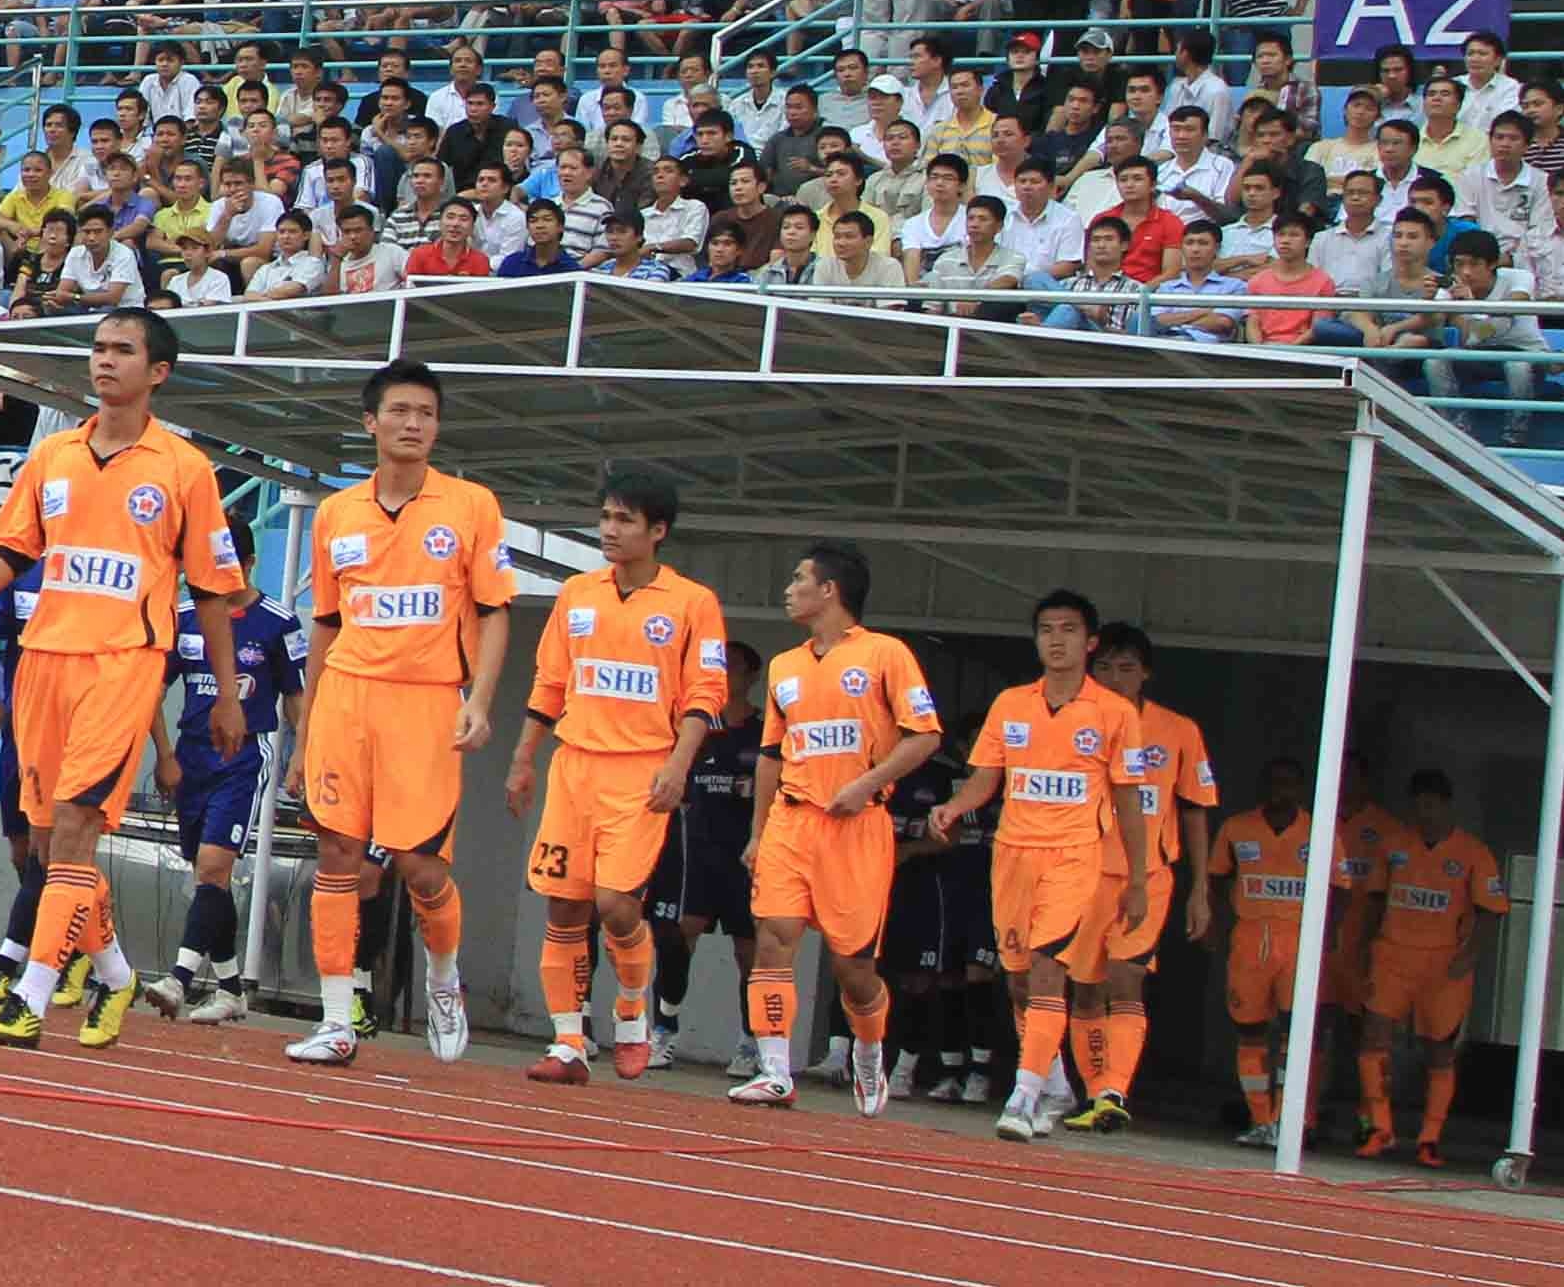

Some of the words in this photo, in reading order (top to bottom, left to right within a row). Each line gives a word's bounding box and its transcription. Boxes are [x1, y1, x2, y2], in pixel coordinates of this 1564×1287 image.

[68, 553, 136, 591] SHB
[378, 591, 440, 619] SHB
[597, 666, 654, 695] SHB
[808, 724, 857, 749] SHB
[1029, 775, 1083, 798] SHB
[231, 824, 243, 844] 6
[532, 842, 570, 879] 23
